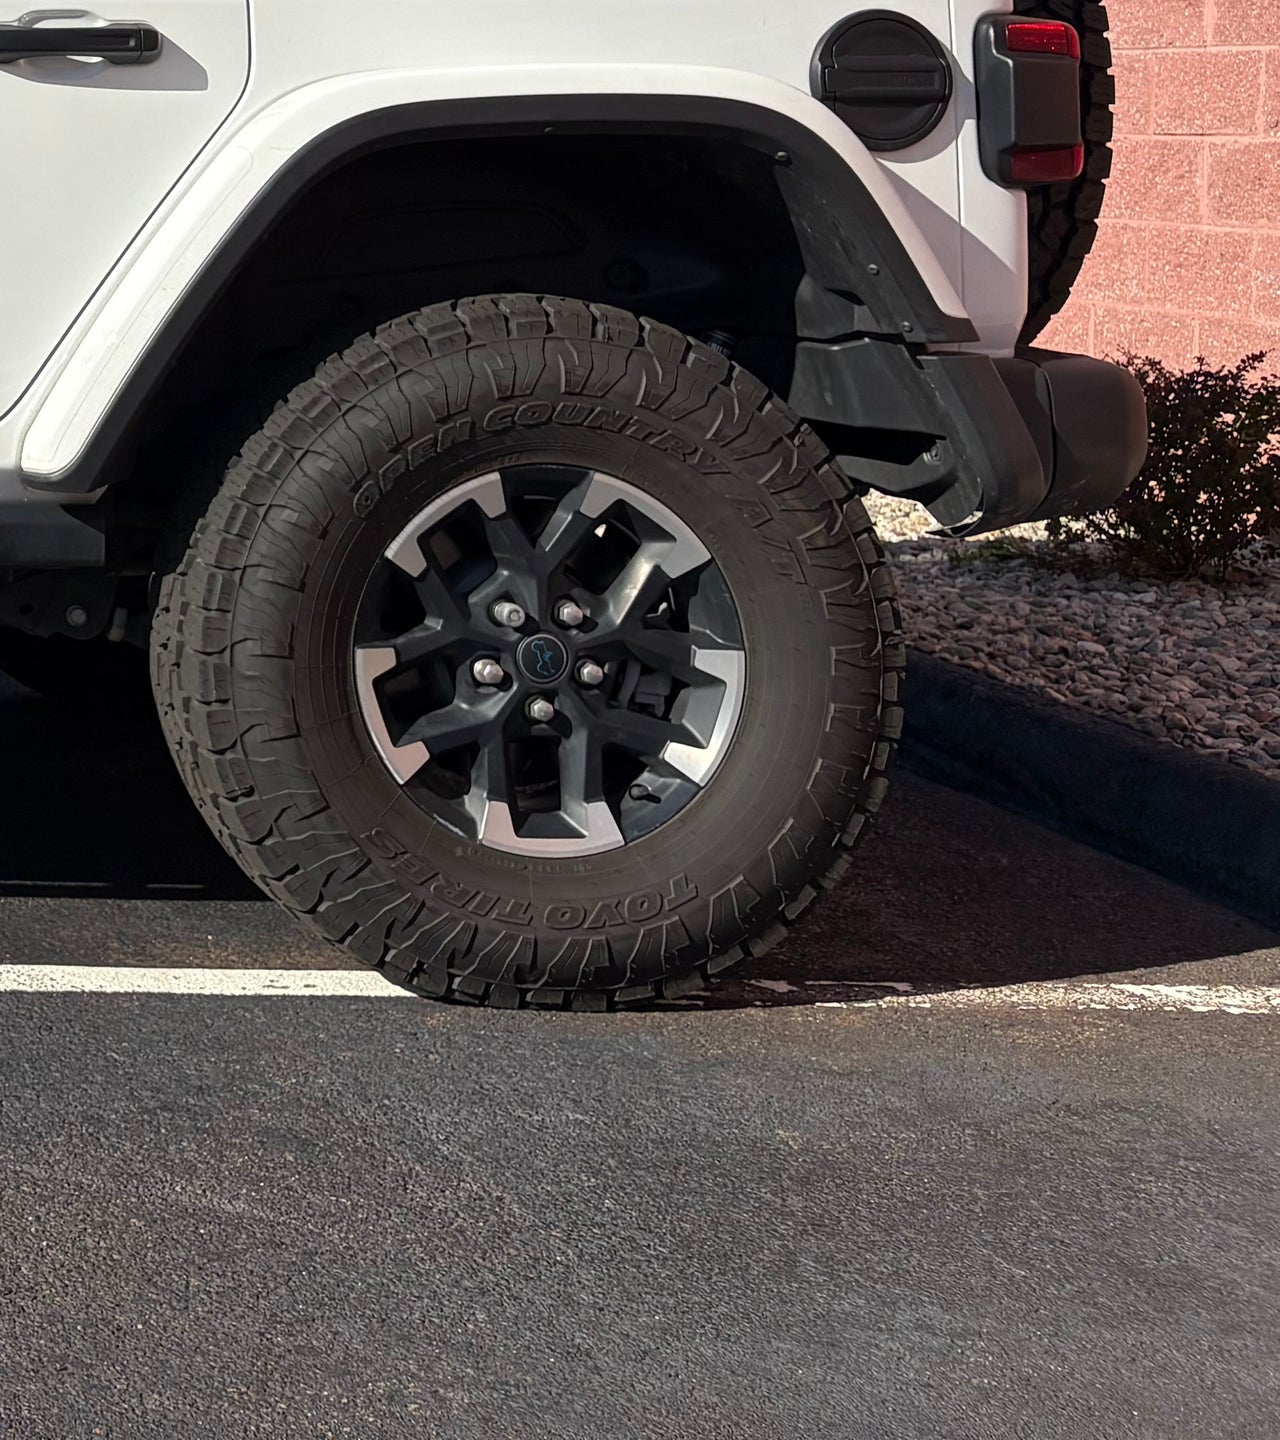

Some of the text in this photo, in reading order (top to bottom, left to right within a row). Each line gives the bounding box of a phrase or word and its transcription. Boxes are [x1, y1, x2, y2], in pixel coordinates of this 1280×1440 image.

[353, 416, 476, 517] OPEN
[483, 401, 731, 475] COUNTRY
[360, 825, 698, 930] TOYO TIRES
